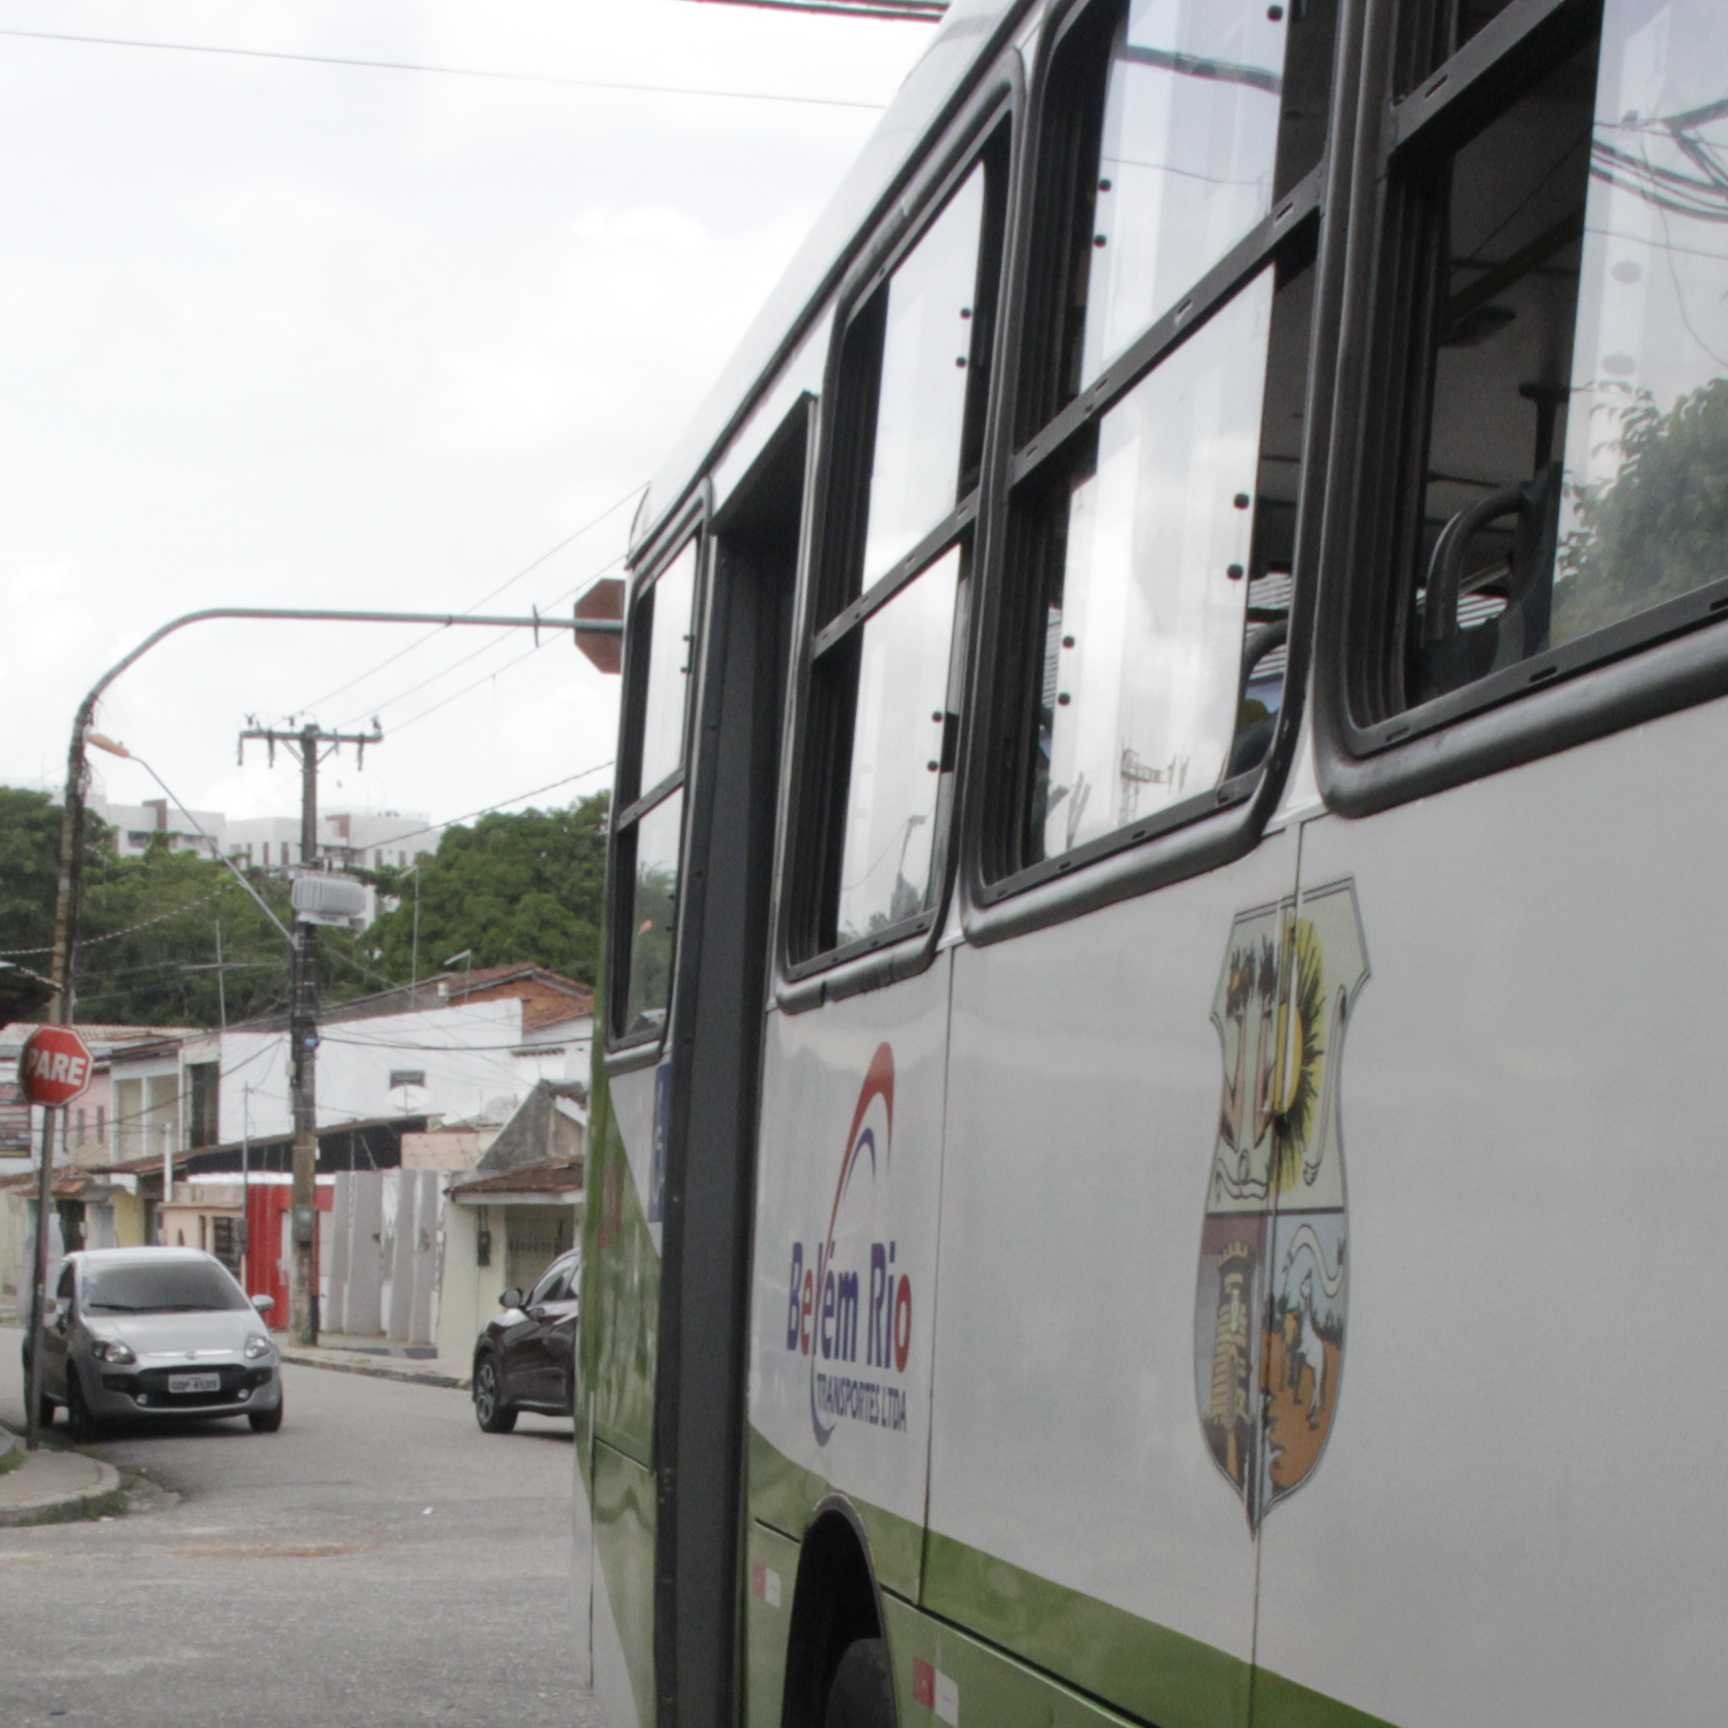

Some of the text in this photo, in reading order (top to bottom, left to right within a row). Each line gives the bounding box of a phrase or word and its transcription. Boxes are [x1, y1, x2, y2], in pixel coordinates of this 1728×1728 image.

[28, 1049, 87, 1086] PARE
[786, 1241, 912, 1374] Belém Rio
